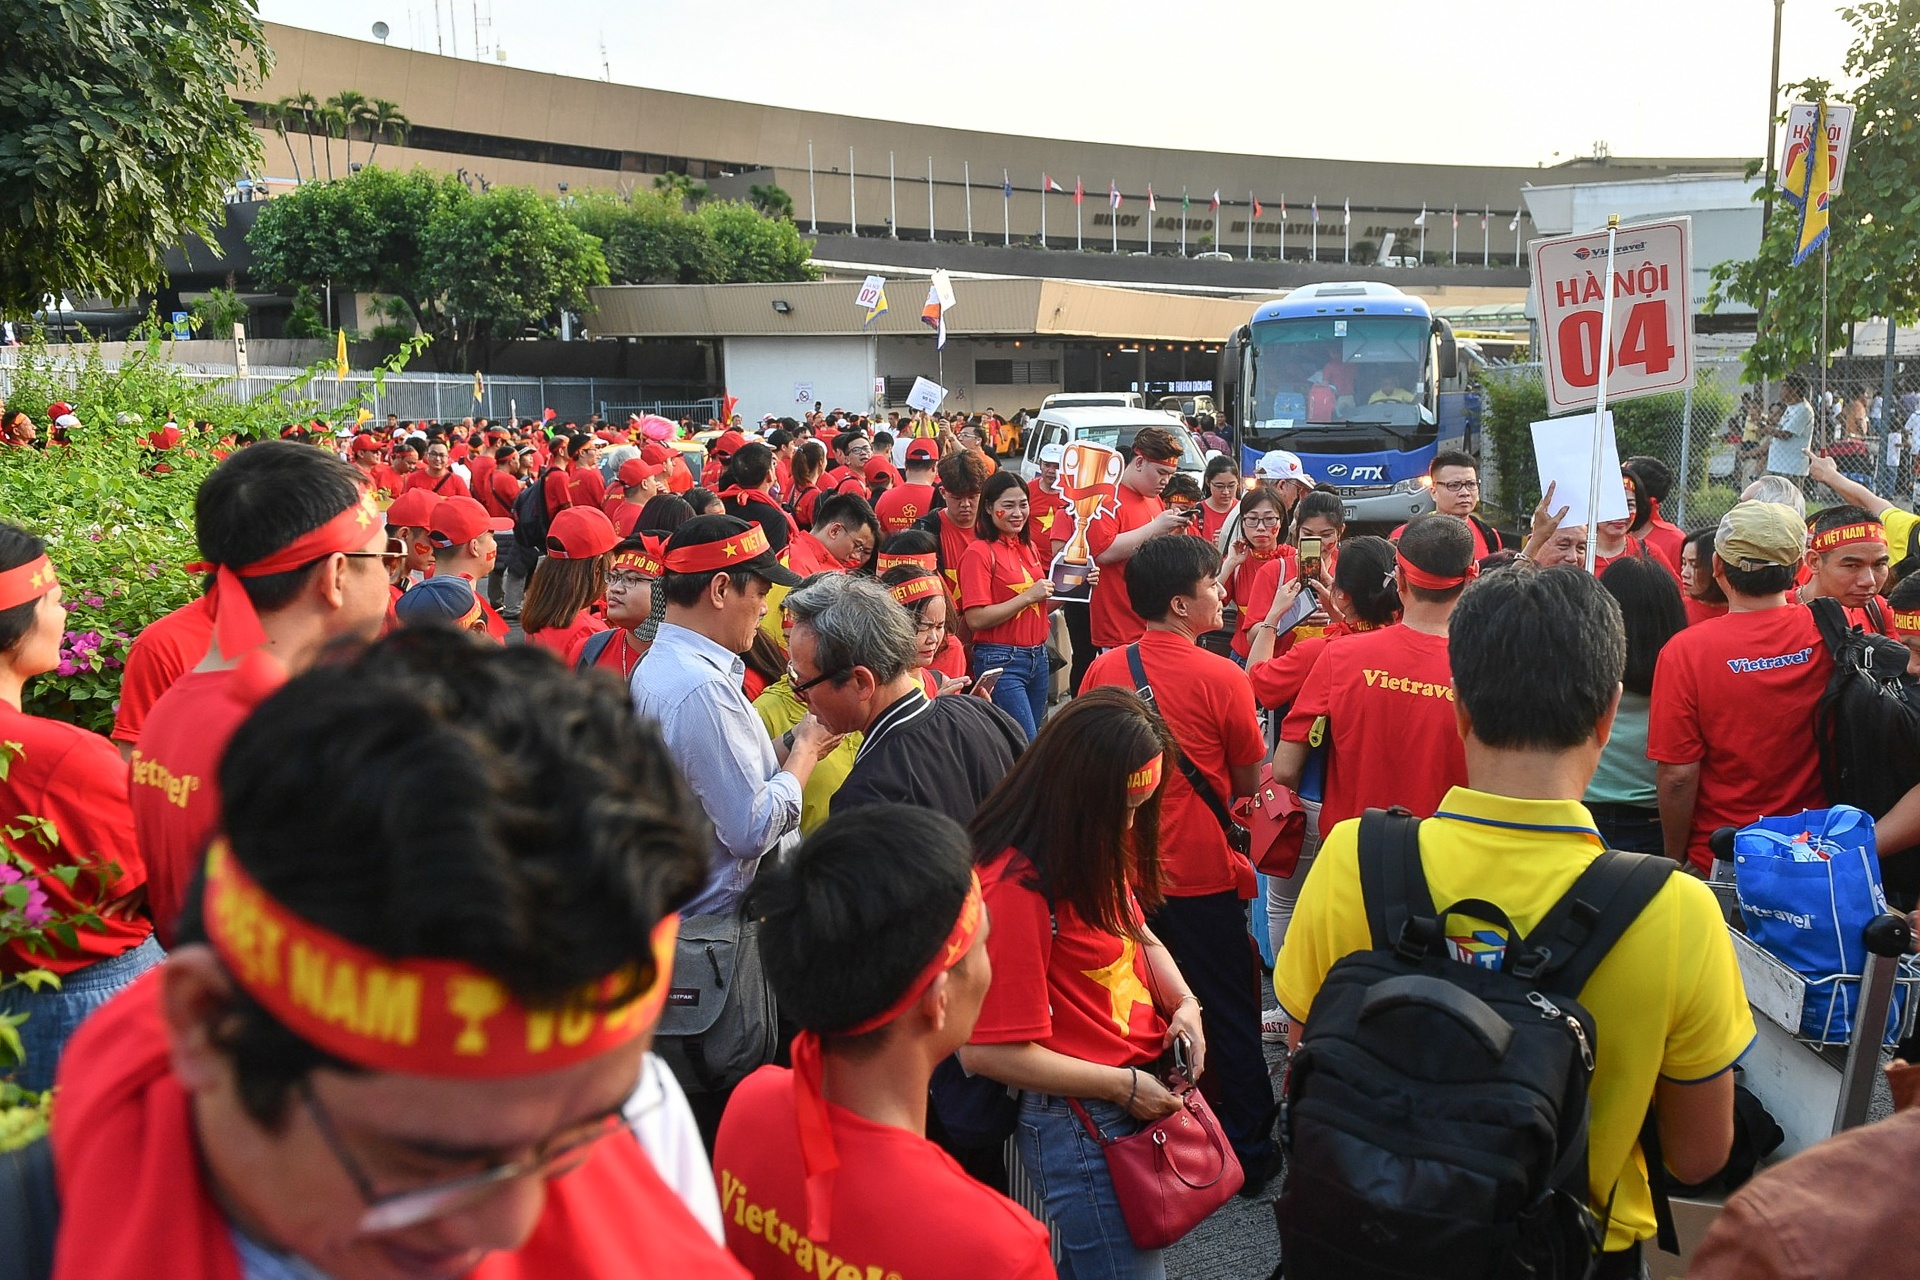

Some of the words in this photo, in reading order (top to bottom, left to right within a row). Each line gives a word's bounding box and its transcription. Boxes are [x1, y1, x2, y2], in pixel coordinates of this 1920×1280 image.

[860, 288, 877, 304] 02
[1555, 270, 1605, 307] HÀ
[1558, 299, 1675, 388] 04
[1351, 466, 1383, 480] PTX
[1823, 529, 1841, 546] VIỆT
[1842, 525, 1866, 540] NAM
[907, 580, 929, 595] NAM
[1362, 669, 1455, 702] Vietrave
[290, 944, 423, 1047] NAM
[1261, 1021, 1289, 1033] BOSTO
